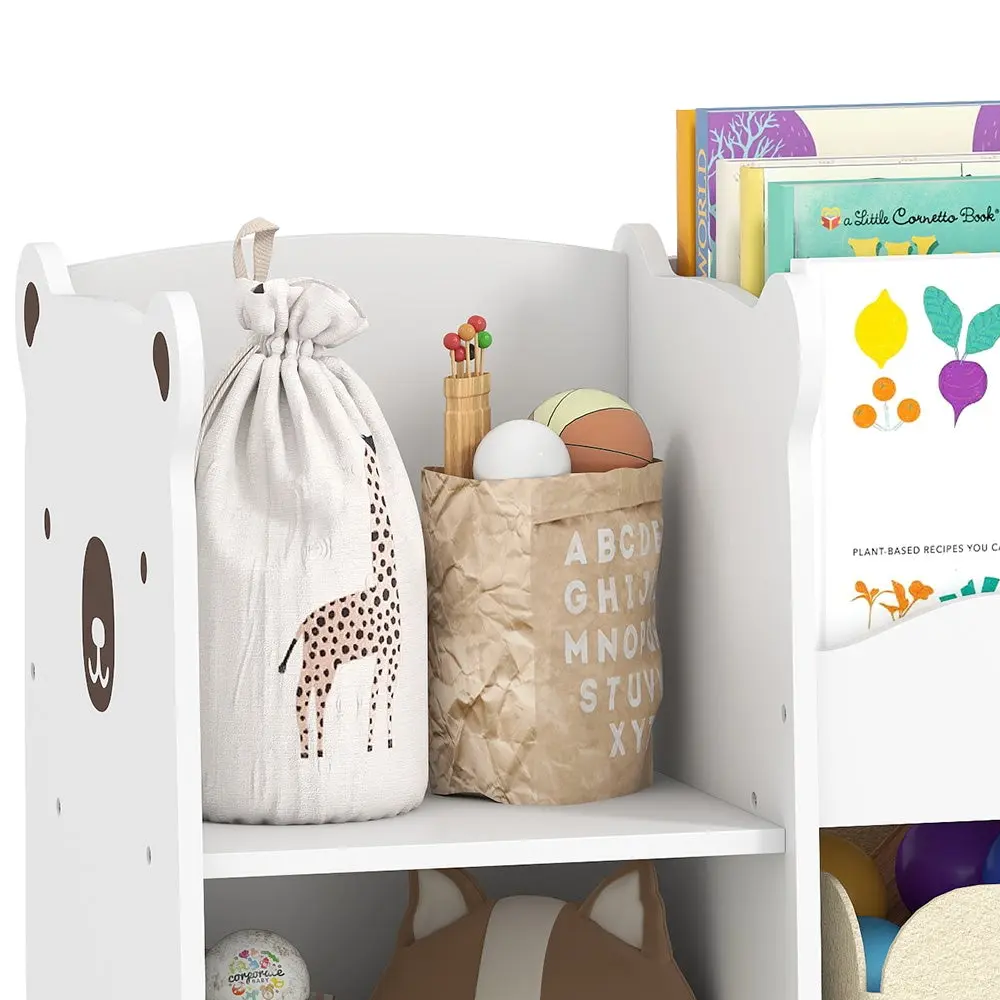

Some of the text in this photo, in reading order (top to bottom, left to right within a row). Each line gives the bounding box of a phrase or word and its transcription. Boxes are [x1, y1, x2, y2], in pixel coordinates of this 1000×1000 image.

[697, 149, 708, 279] WORLD
[843, 216, 852, 226] a
[854, 209, 890, 226] Little
[892, 207, 959, 226] Cornetto
[852, 545, 921, 557] PLANT-BASED
[923, 544, 964, 554] RECIPES
[967, 543, 988, 552] YOU
[579, 667, 662, 714] STUV
